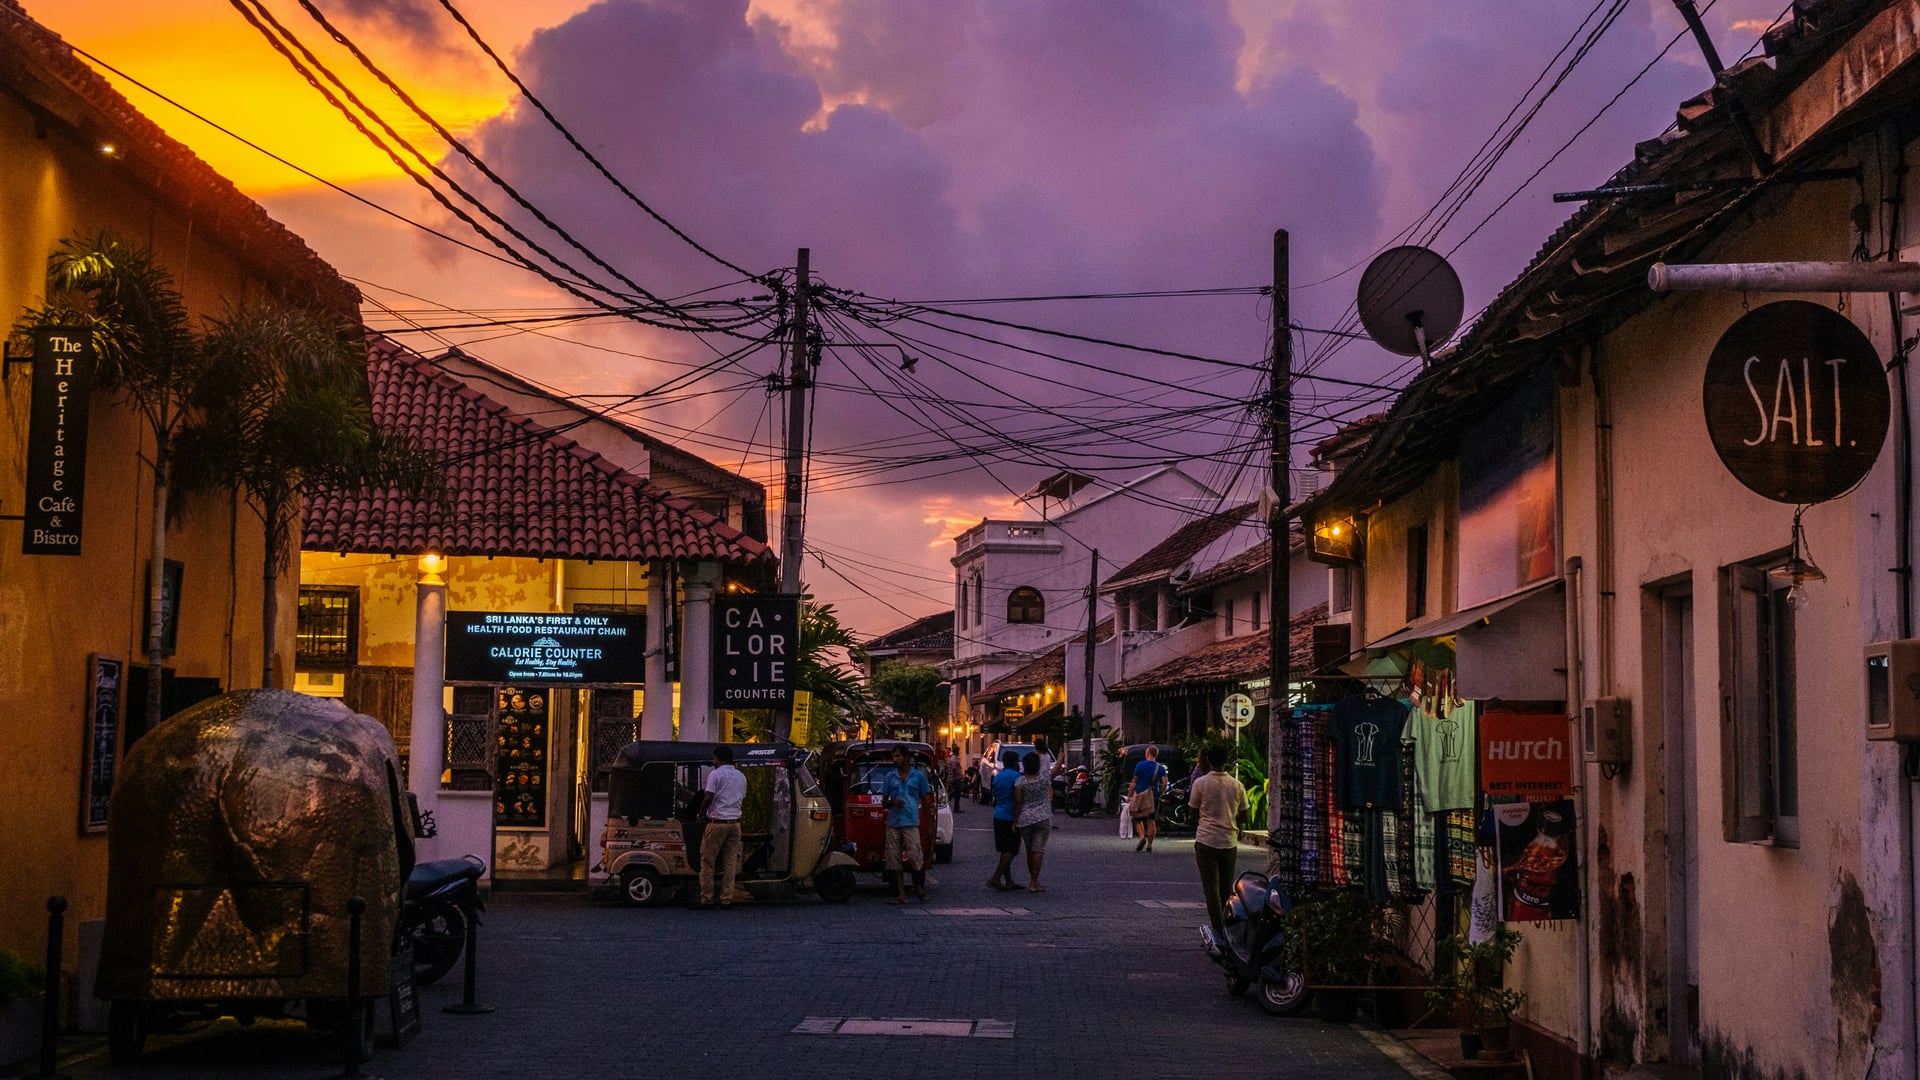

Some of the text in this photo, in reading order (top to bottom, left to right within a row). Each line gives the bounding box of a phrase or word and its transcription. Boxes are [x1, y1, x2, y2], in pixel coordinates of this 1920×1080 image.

[49, 336, 82, 353] The
[1743, 356, 1857, 447] SALT.
[54, 358, 73, 491] Heritage
[39, 496, 76, 512] Café
[51, 515, 62, 527] &
[33, 529, 79, 545] Bistro
[486, 615, 609, 626] SRI LANKA'S FIRST & ONLY
[467, 624, 627, 636] HEALTH FOOD RESTAURANT CHAIN
[491, 647, 602, 660] CALORIE COUNTER
[725, 689, 786, 699] COUNTER
[1490, 781, 1563, 790] BEST INTERNET
[1521, 892, 1540, 904] zero
